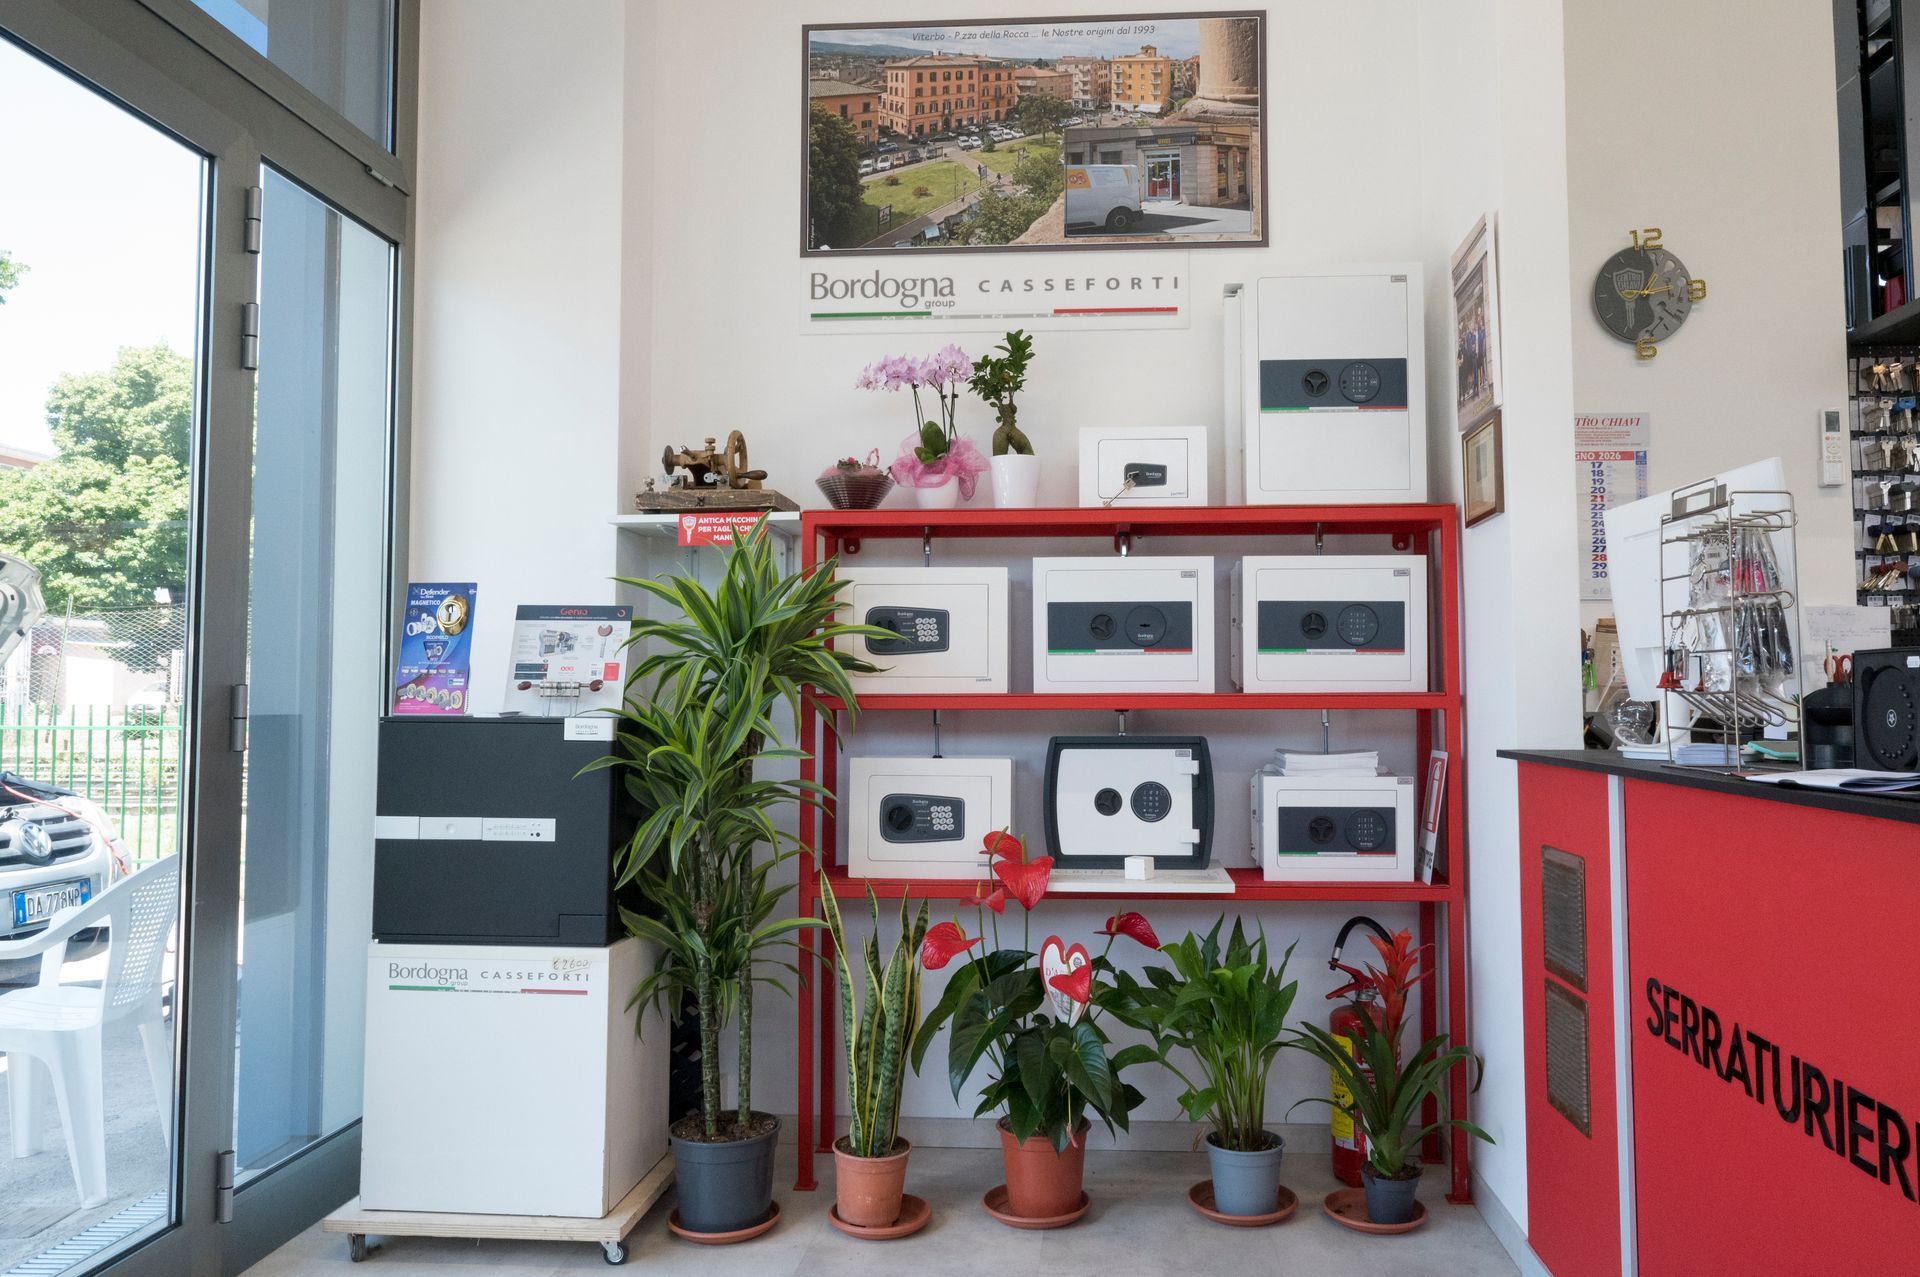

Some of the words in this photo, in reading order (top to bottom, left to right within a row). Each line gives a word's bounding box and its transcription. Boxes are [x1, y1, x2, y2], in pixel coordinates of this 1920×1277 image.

[912, 32, 945, 41] Viterbo
[954, 31, 977, 40] P.zza
[979, 30, 1001, 39] della
[1003, 30, 1029, 39] Rocca
[1041, 28, 1050, 38] le
[1052, 28, 1084, 37] Nostre
[1086, 27, 1115, 38] origini
[1117, 26, 1131, 36] dal
[1133, 25, 1155, 34] 1993
[1629, 228, 1663, 251] 12
[810, 269, 956, 308] Bordogna
[978, 276, 1179, 293] CASSEFORTI
[1687, 279, 1707, 302] 3
[924, 300, 956, 309] group
[1636, 337, 1657, 360] 6
[1601, 417, 1641, 427] CHIAVI
[1598, 452, 1621, 460] 2026
[1590, 461, 1604, 469] 17
[1591, 469, 1604, 477] 18
[1591, 478, 1605, 486] 19
[1590, 486, 1606, 494] 20
[1590, 503, 1606, 511] 22
[1591, 520, 1605, 528] 24
[697, 525, 712, 533] PER
[1591, 528, 1606, 536] 25
[1591, 536, 1607, 545] 26
[1591, 545, 1607, 553] 27
[1591, 553, 1608, 562] 28
[1591, 562, 1608, 570] 29
[1591, 570, 1608, 579] 30
[420, 588, 450, 596] Defender
[560, 608, 588, 616] Genio
[27, 895, 43, 917] DA
[388, 962, 469, 985] Bordogna
[480, 970, 590, 982] CASSEFORTI
[1646, 977, 1920, 1205] SERRATURIER
